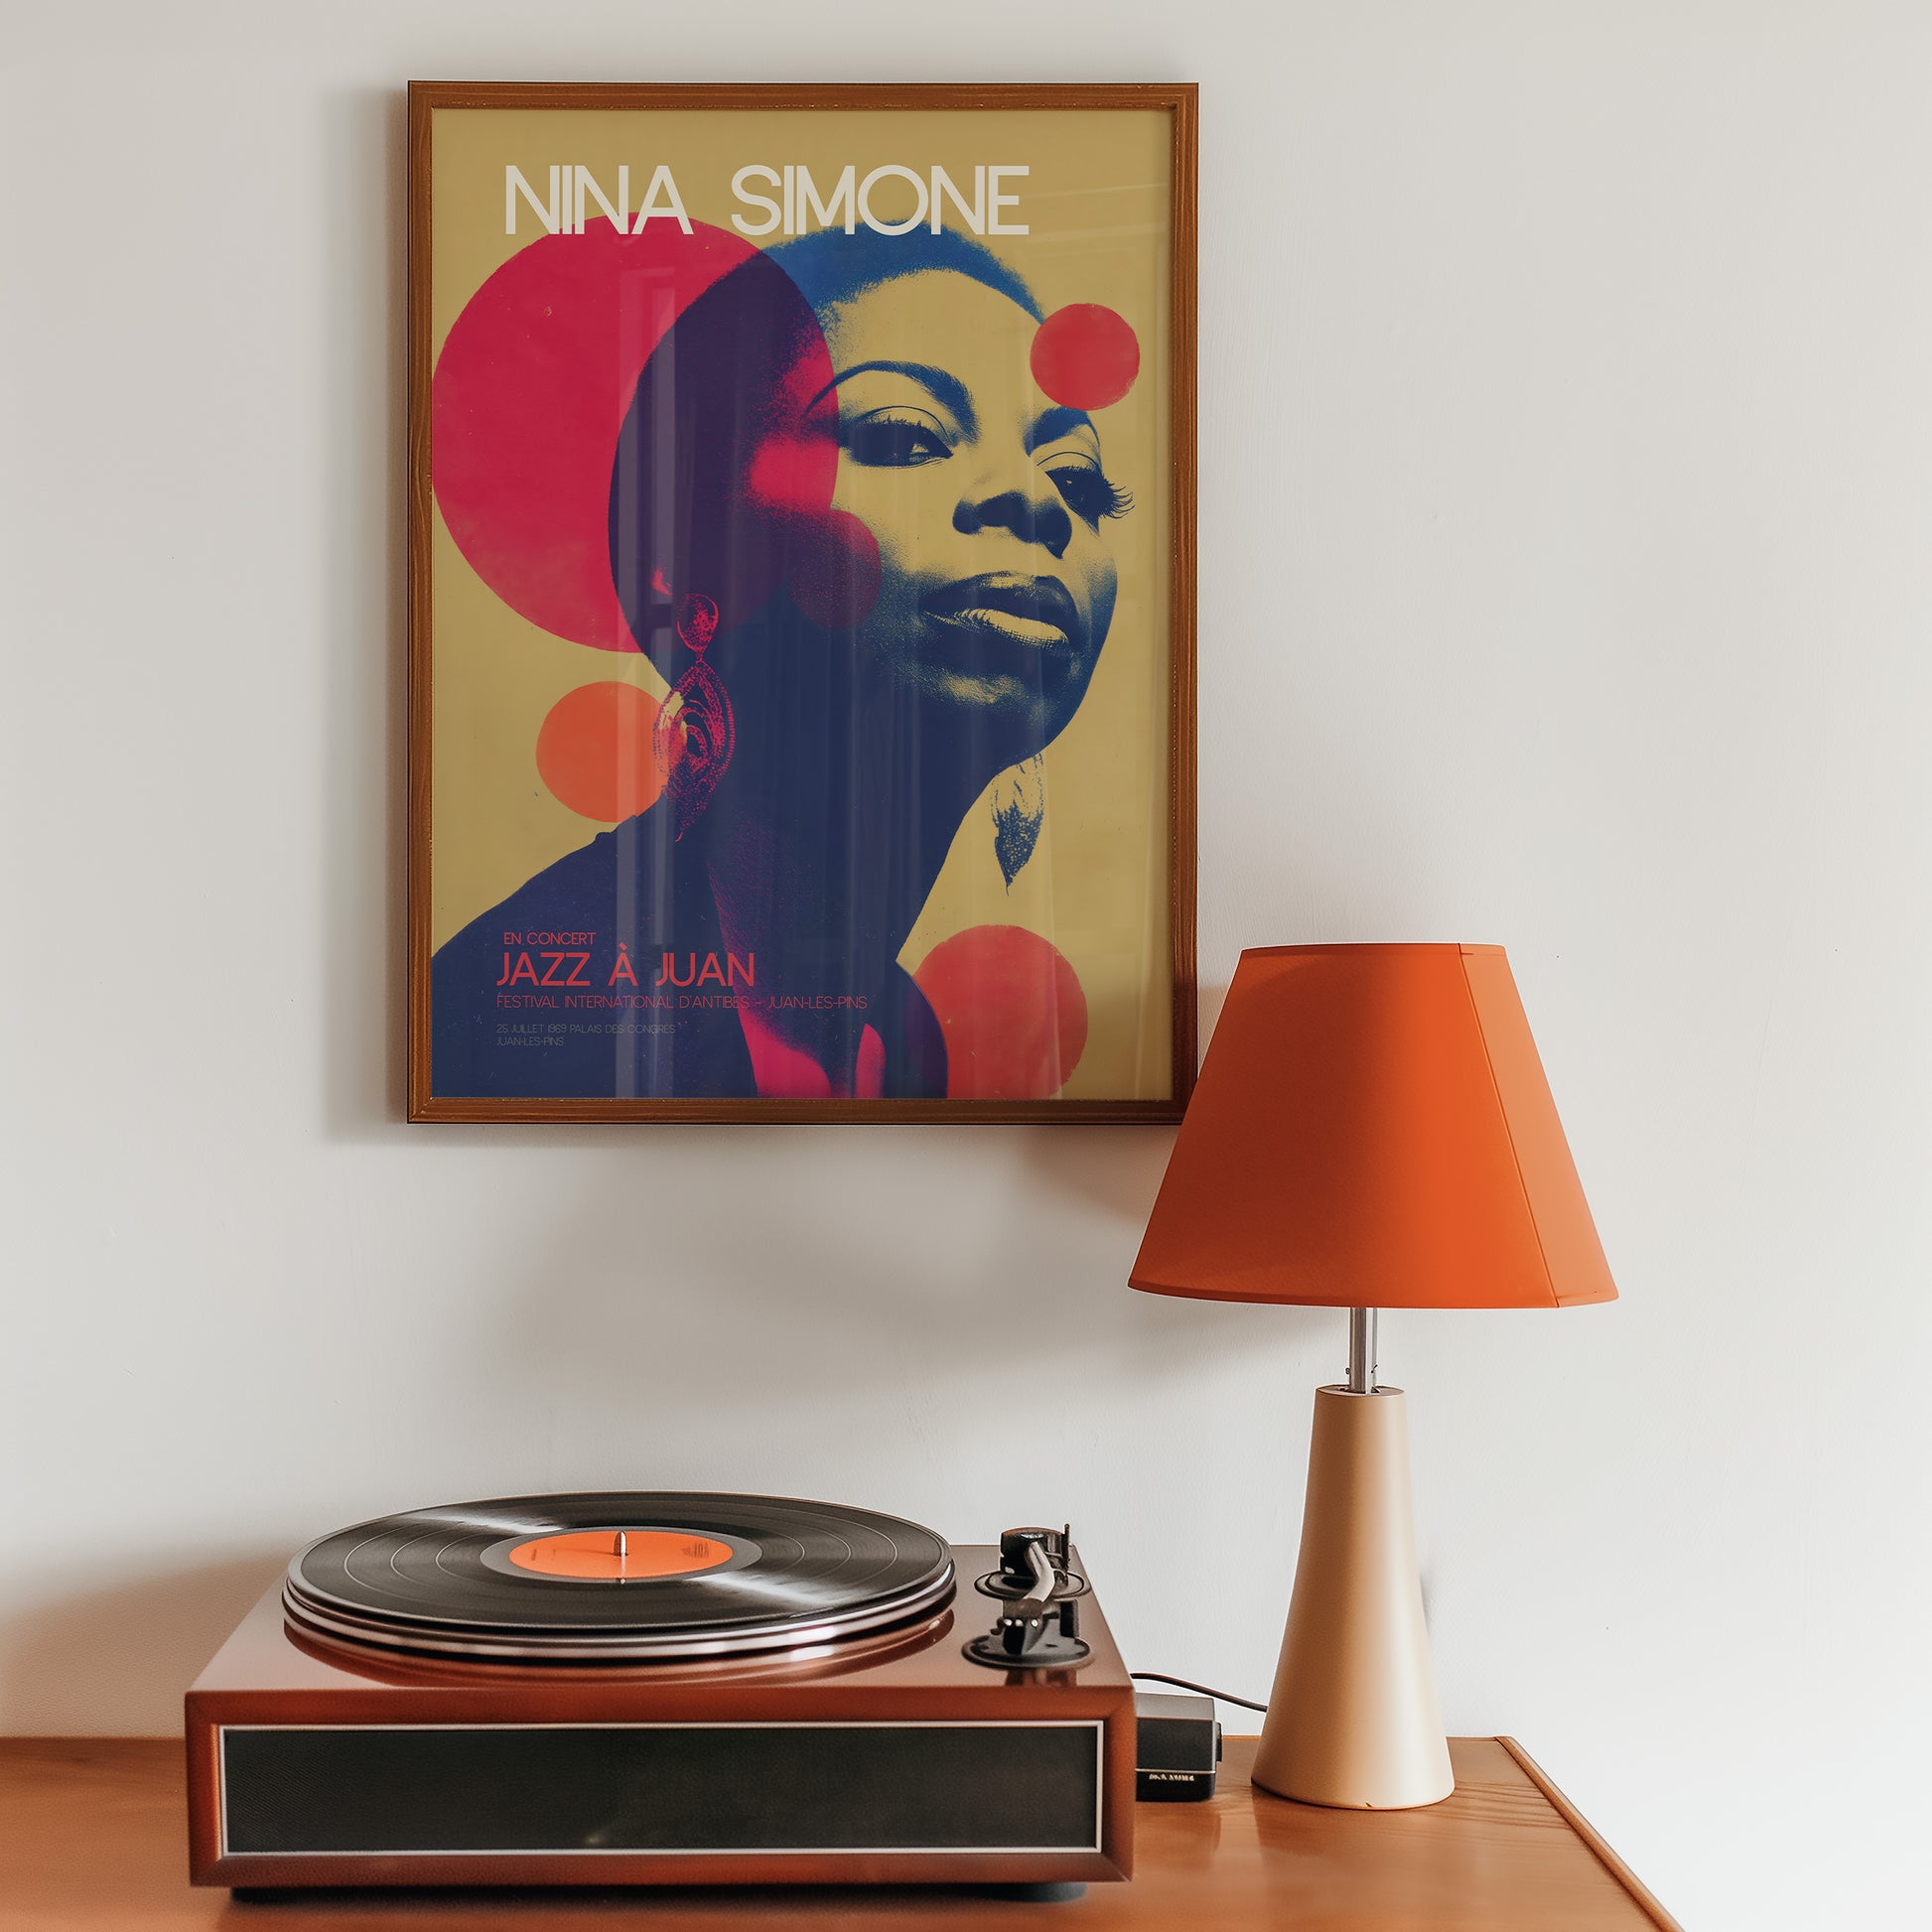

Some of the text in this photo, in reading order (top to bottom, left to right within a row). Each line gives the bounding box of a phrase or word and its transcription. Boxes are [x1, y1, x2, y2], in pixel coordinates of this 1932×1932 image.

[504, 165, 1030, 236] NINA SIMONE
[503, 932, 596, 945] EN CONCERT
[496, 942, 755, 987] JAZZ À JUAN
[496, 996, 560, 1009] FESTIVAL
[565, 996, 674, 1009] INTERNATIONAL
[679, 996, 750, 1009] D'ANTIBES
[768, 996, 868, 1009] JUAN-LES-PINS
[496, 1024, 508, 1034] 25
[512, 1024, 545, 1034] JUILLET
[569, 1024, 603, 1034] PALAIS
[605, 1024, 624, 1034] DES
[497, 1036, 564, 1046] JUAN-LES-PINS
